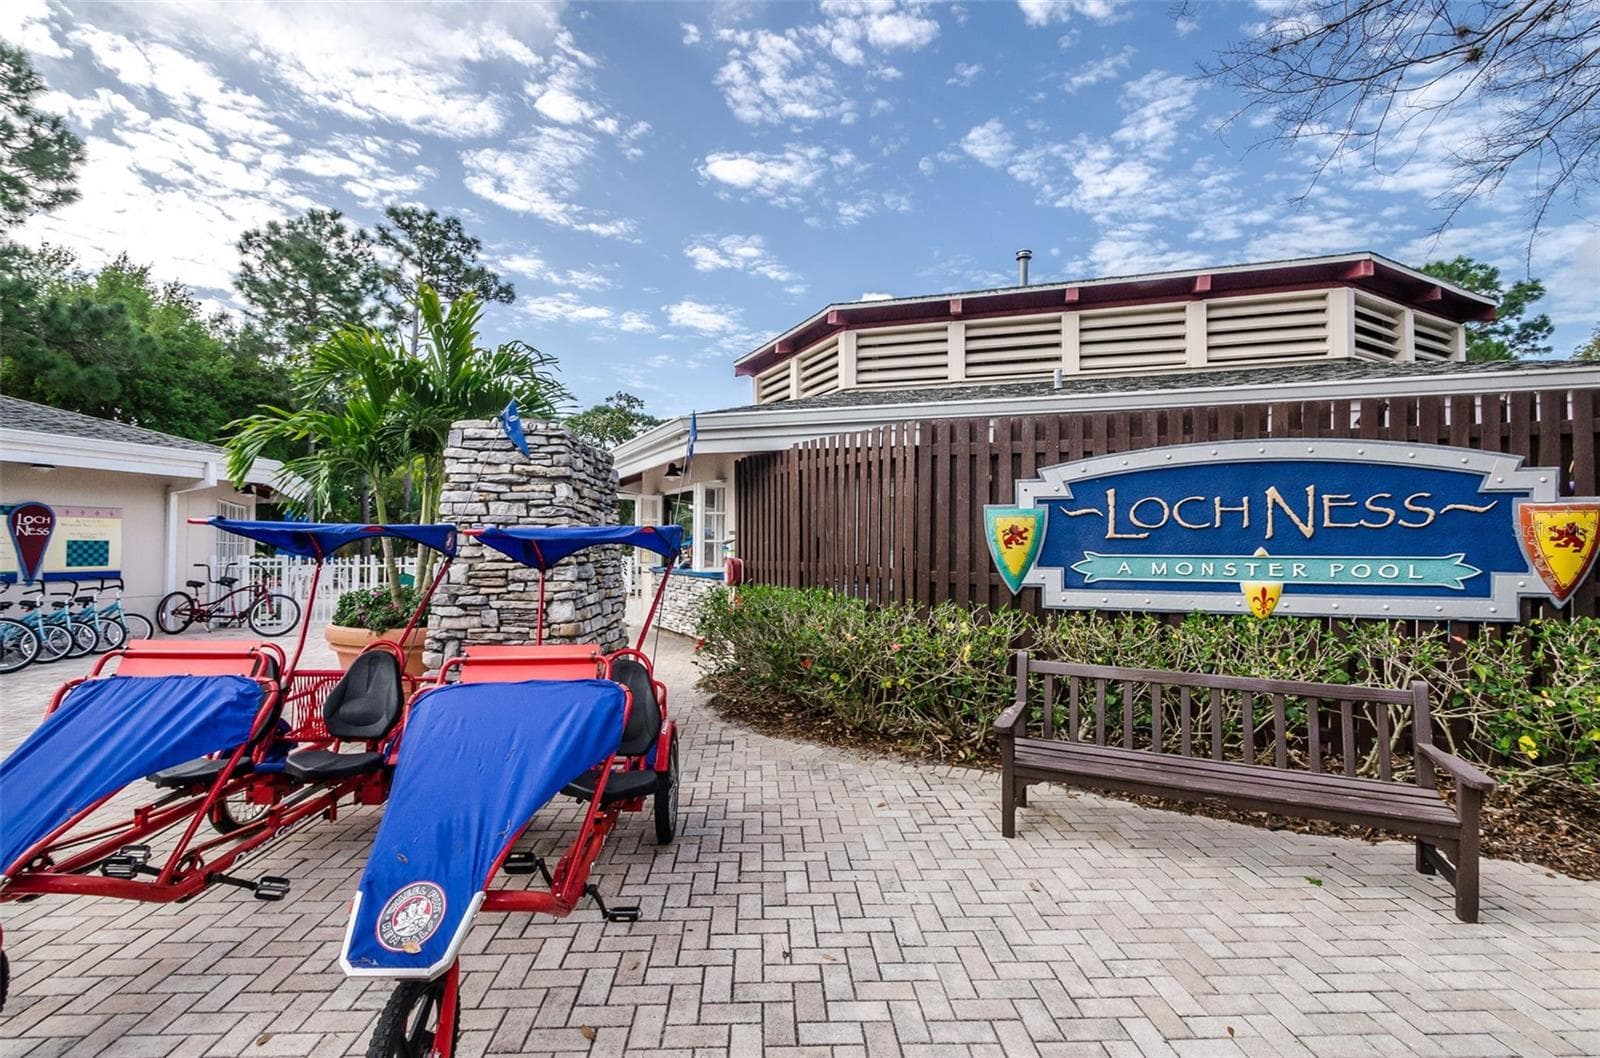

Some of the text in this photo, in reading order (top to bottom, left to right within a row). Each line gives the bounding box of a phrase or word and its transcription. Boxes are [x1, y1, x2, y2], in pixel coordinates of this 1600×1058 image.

[18, 513, 51, 525] LOCH
[1105, 484, 1436, 541] LOCH NESS
[1116, 561, 1424, 580] A MONSTER POOL
